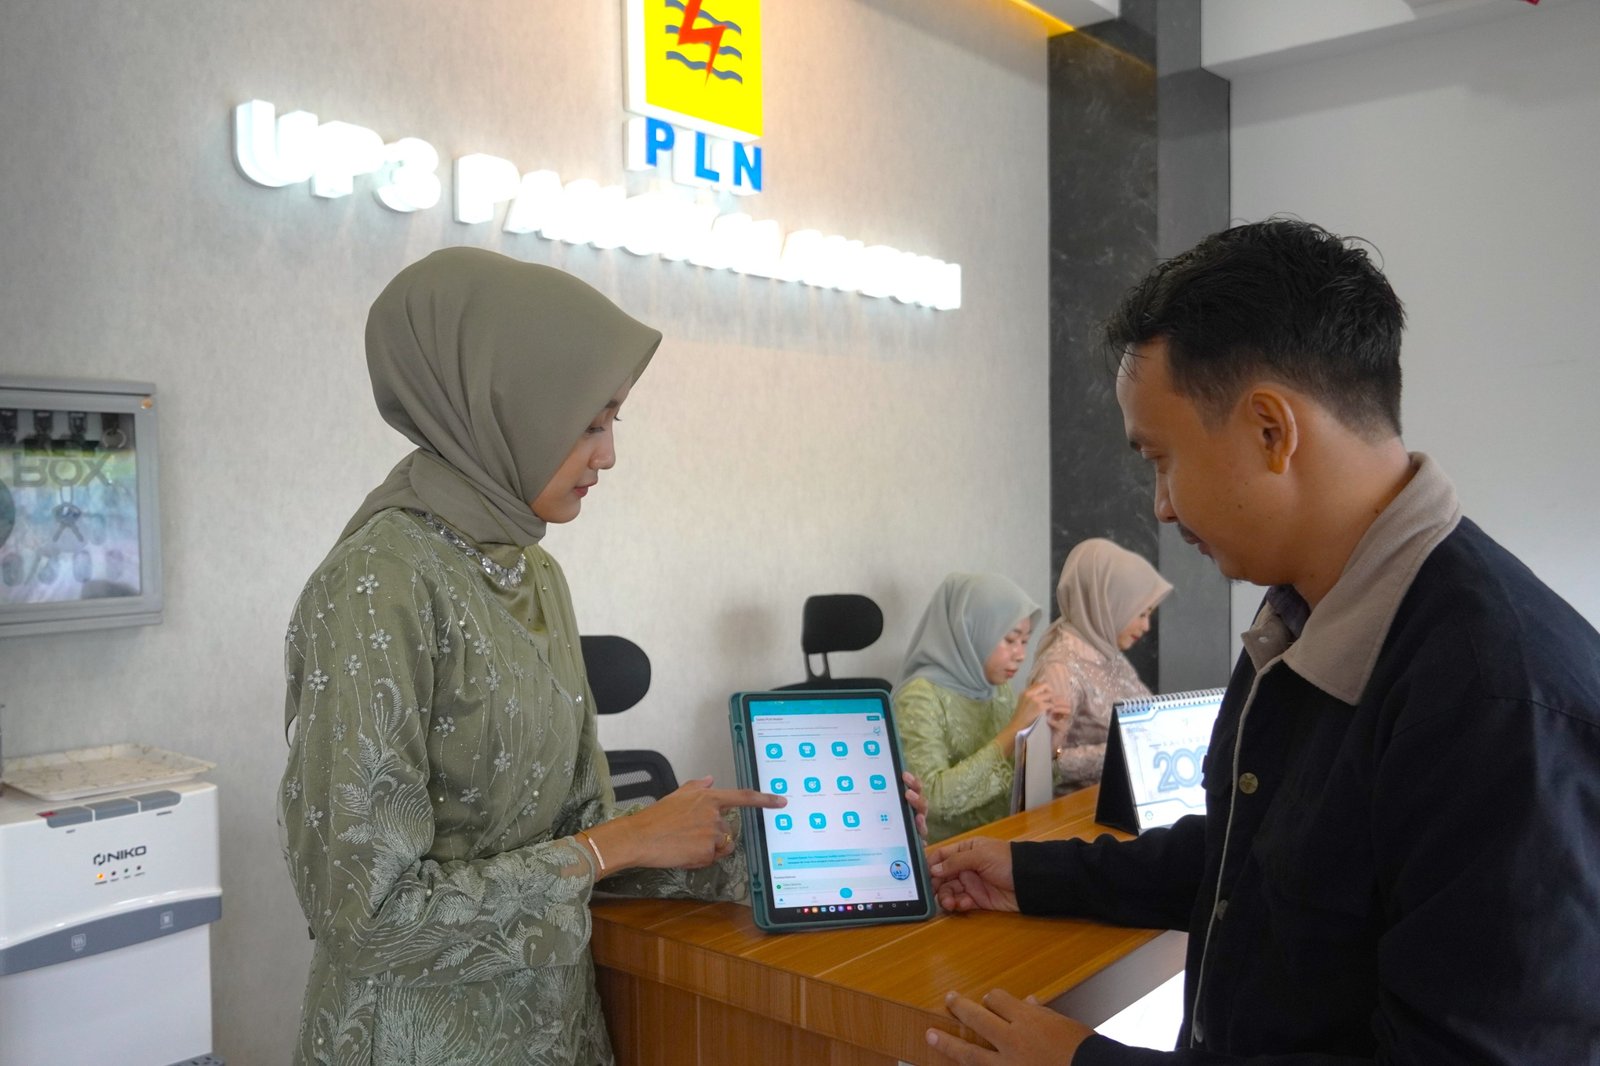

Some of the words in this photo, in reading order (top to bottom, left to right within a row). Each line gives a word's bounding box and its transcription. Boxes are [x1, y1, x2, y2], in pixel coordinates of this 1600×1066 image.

[233, 99, 441, 212] UP3
[646, 115, 763, 193] PLN
[12, 451, 113, 488] BOX
[107, 845, 147, 862] NIKO
